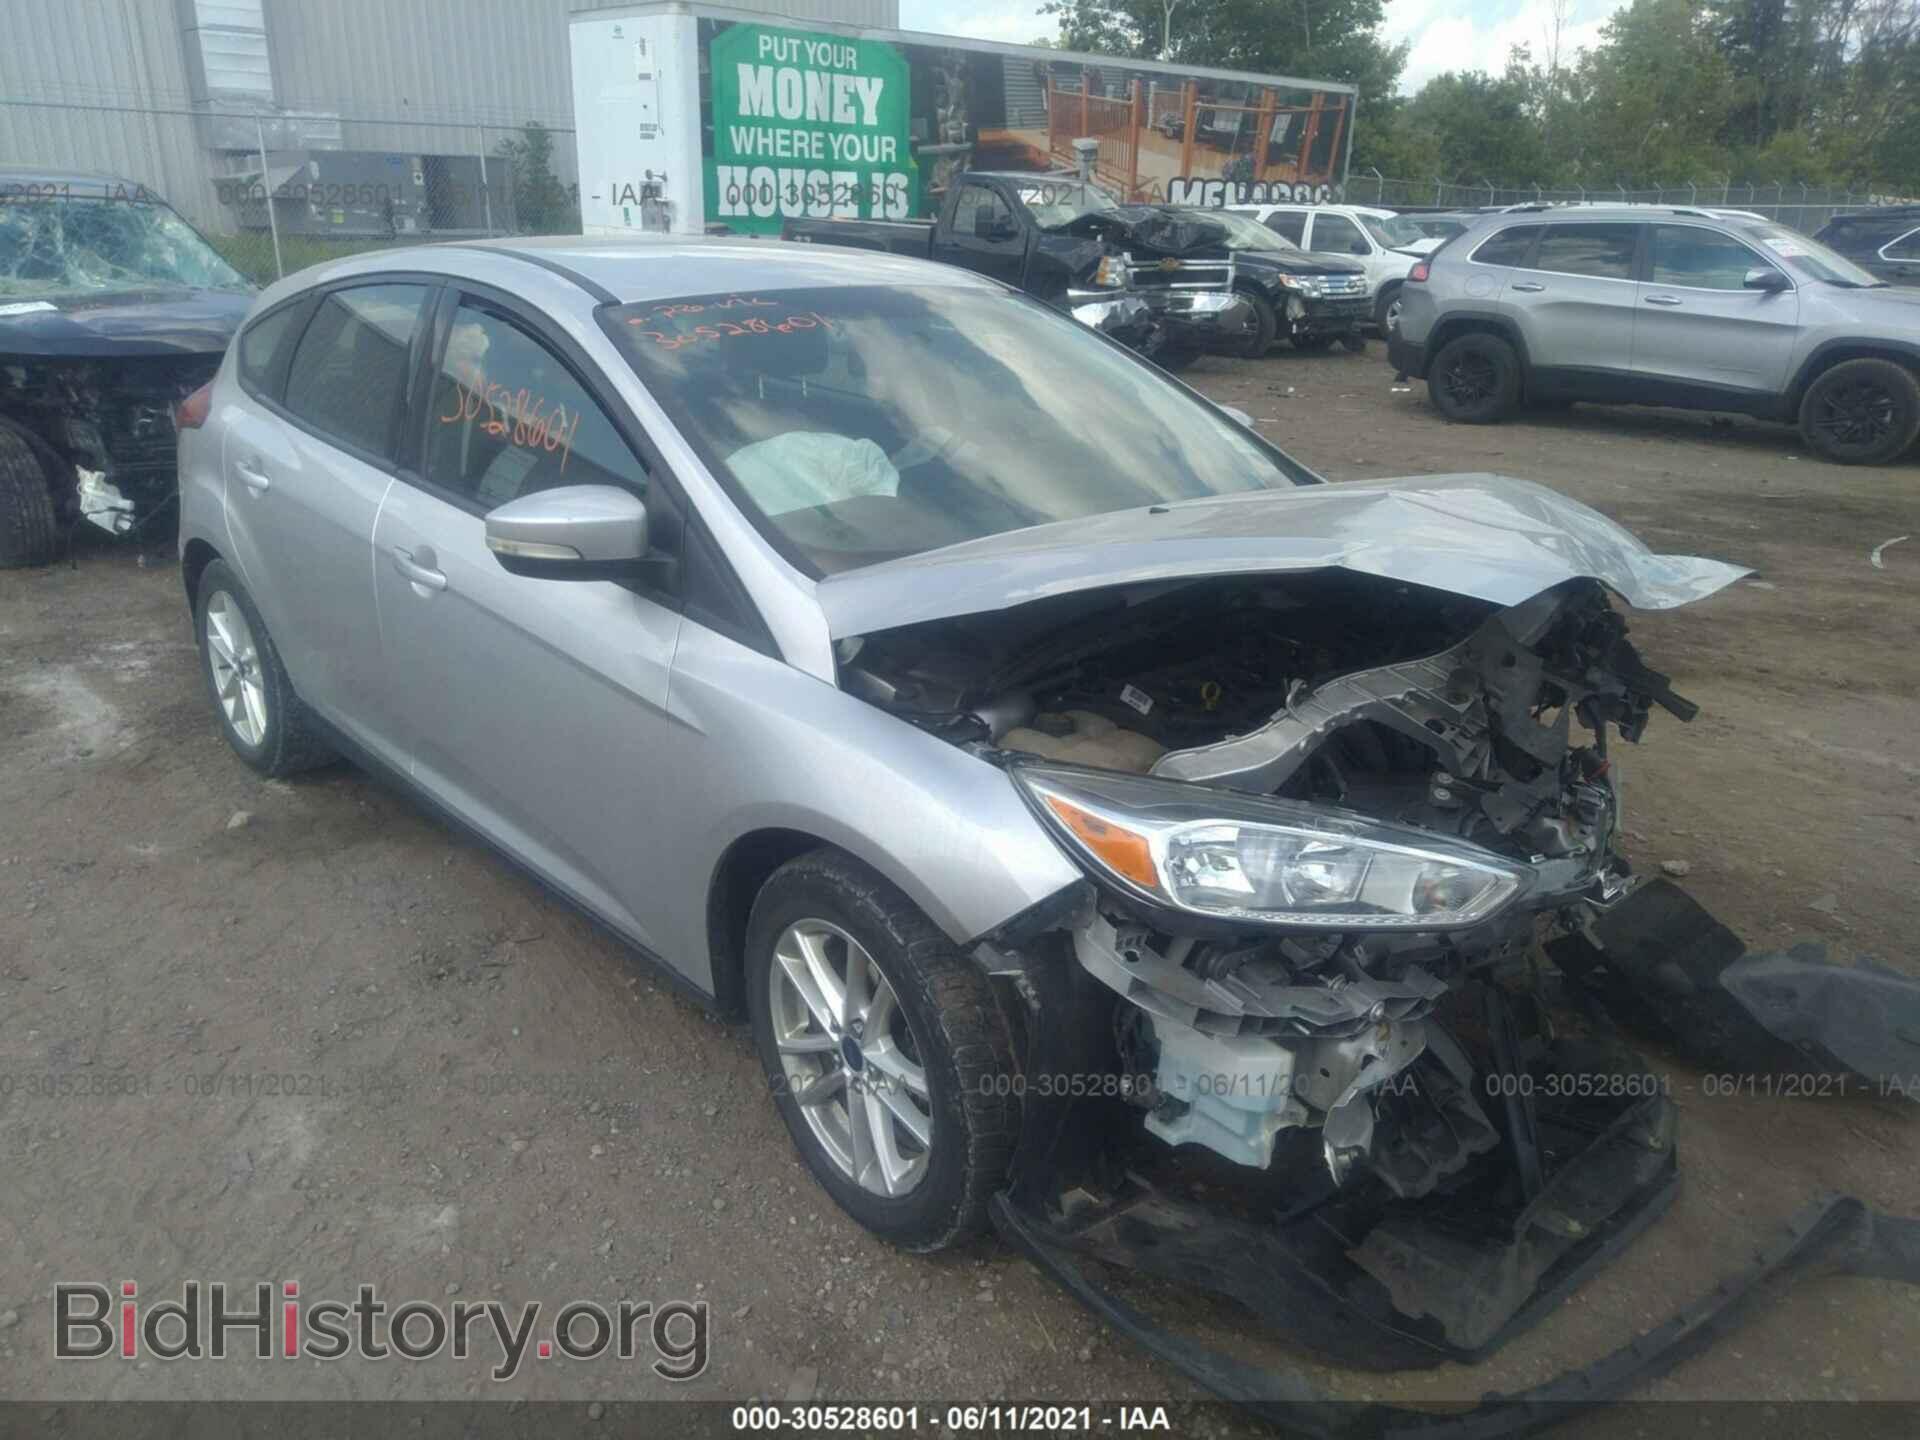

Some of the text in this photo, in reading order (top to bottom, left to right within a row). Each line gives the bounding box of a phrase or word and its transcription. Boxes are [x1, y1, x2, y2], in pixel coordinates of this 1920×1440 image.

[759, 35, 857, 70] PUT YOUR
[737, 62, 884, 126] MONEY
[730, 126, 897, 162] WHERE YOUR
[717, 165, 909, 219] HOUSE IS
